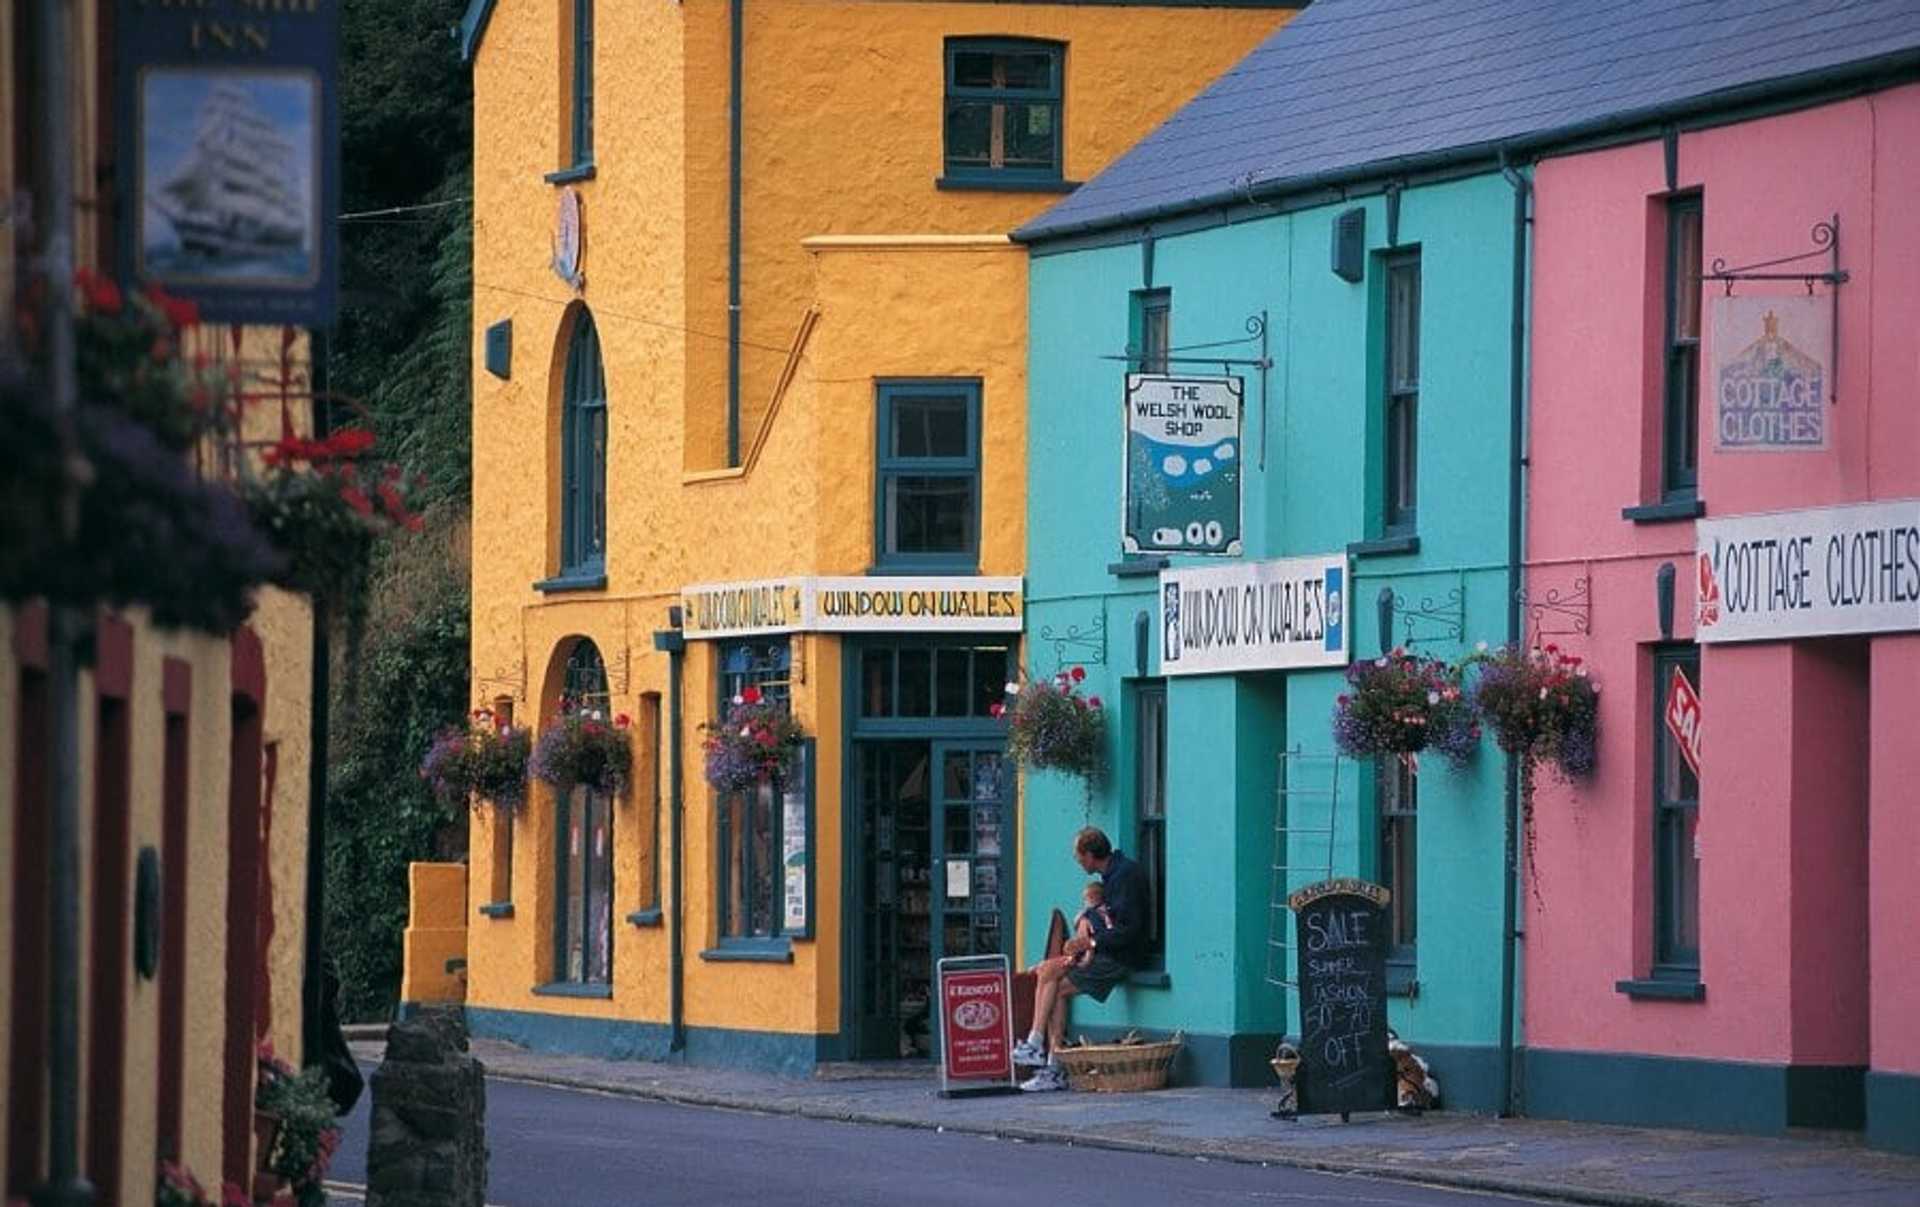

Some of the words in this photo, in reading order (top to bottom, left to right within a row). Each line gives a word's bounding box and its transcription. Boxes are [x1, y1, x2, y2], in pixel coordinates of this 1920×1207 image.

[1171, 386, 1200, 401] THE
[1721, 377, 1820, 408] COTTAGE
[1136, 403, 1187, 419] WELSH
[1192, 405, 1233, 420] WOOL
[1721, 410, 1823, 442] CLOTHES
[1165, 422, 1203, 437] SHOP
[1724, 536, 1813, 613] COTTAGE
[1825, 526, 1920, 607] CLOTHES
[823, 590, 904, 618] WINDOW
[908, 590, 937, 617] ON
[938, 590, 1015, 617] WALES
[1182, 586, 1239, 650] WINDOW
[1243, 584, 1265, 646] ON
[1269, 578, 1324, 643] WALES
[1307, 911, 1370, 951] SALE
[1324, 1031, 1370, 1069] OFF
